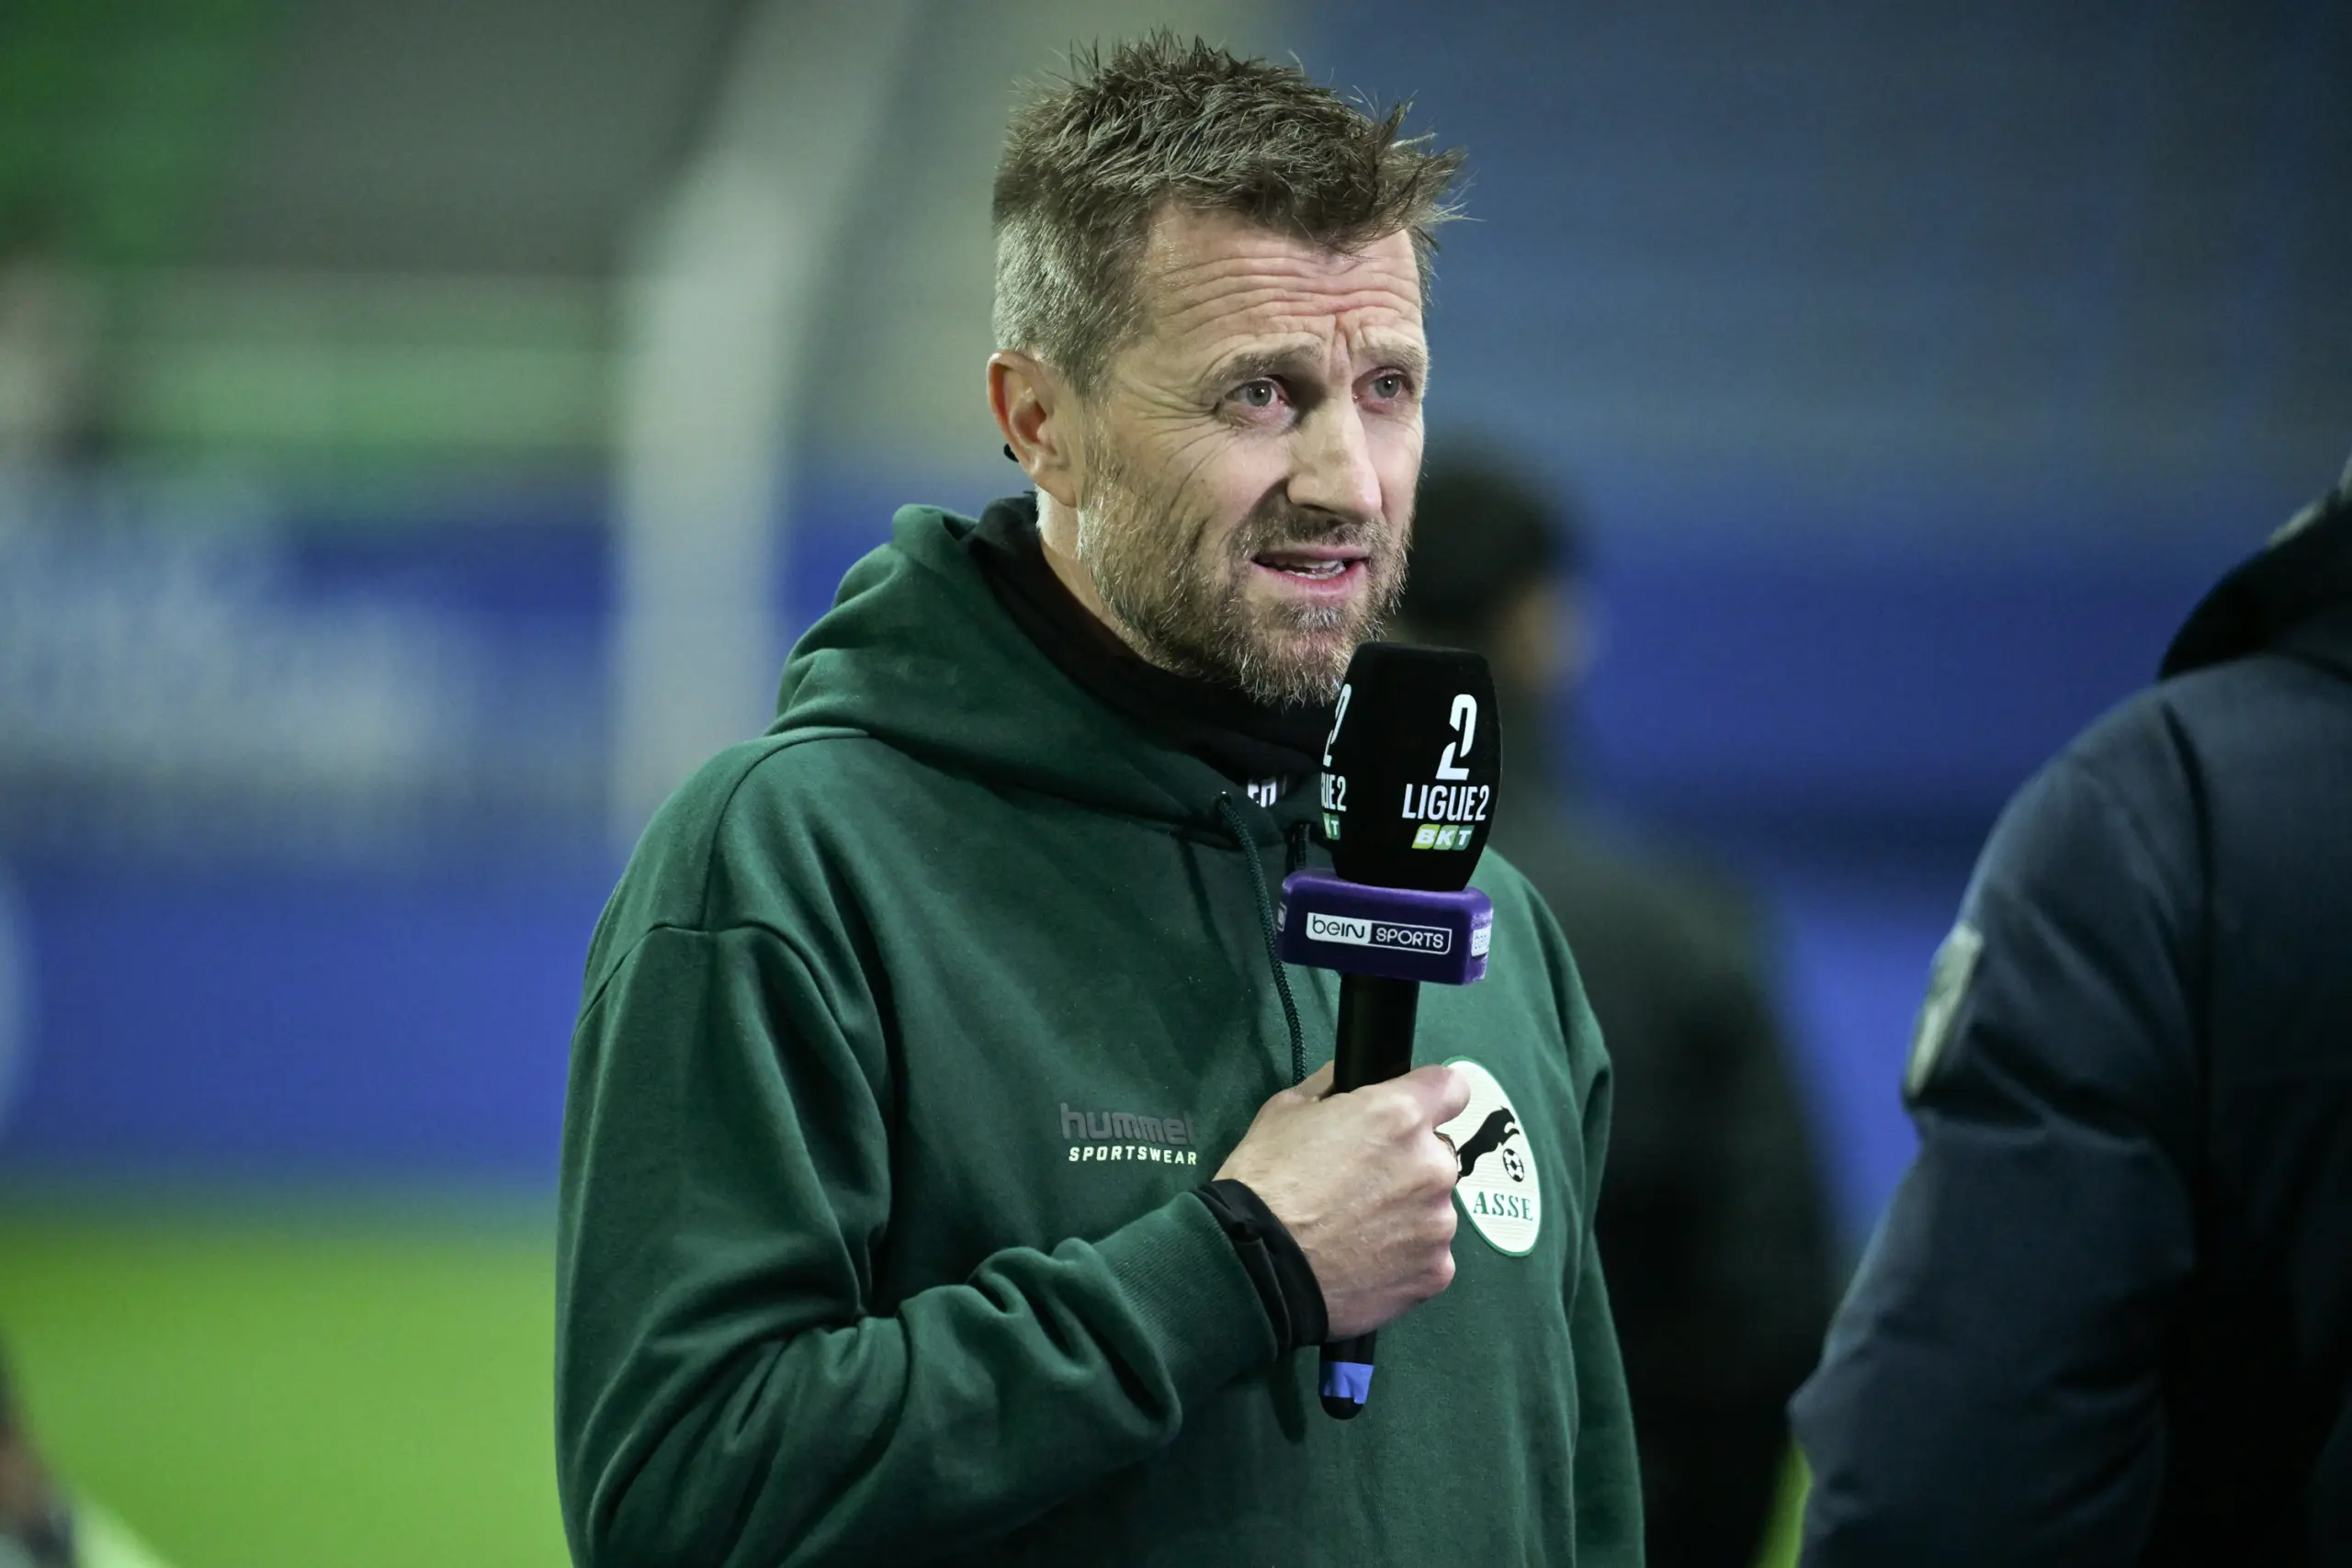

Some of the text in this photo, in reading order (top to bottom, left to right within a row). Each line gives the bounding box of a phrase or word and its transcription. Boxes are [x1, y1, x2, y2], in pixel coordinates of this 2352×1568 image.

[1435, 694, 1477, 780] 2
[1402, 784, 1489, 820] LIGUE2
[1415, 828, 1473, 846] BKT
[1375, 926, 1444, 950] SPORTS
[1060, 1102, 1194, 1145] hummel
[1069, 1145, 1196, 1165] SPORTSWEAR
[1473, 1191, 1533, 1221] ASSE
